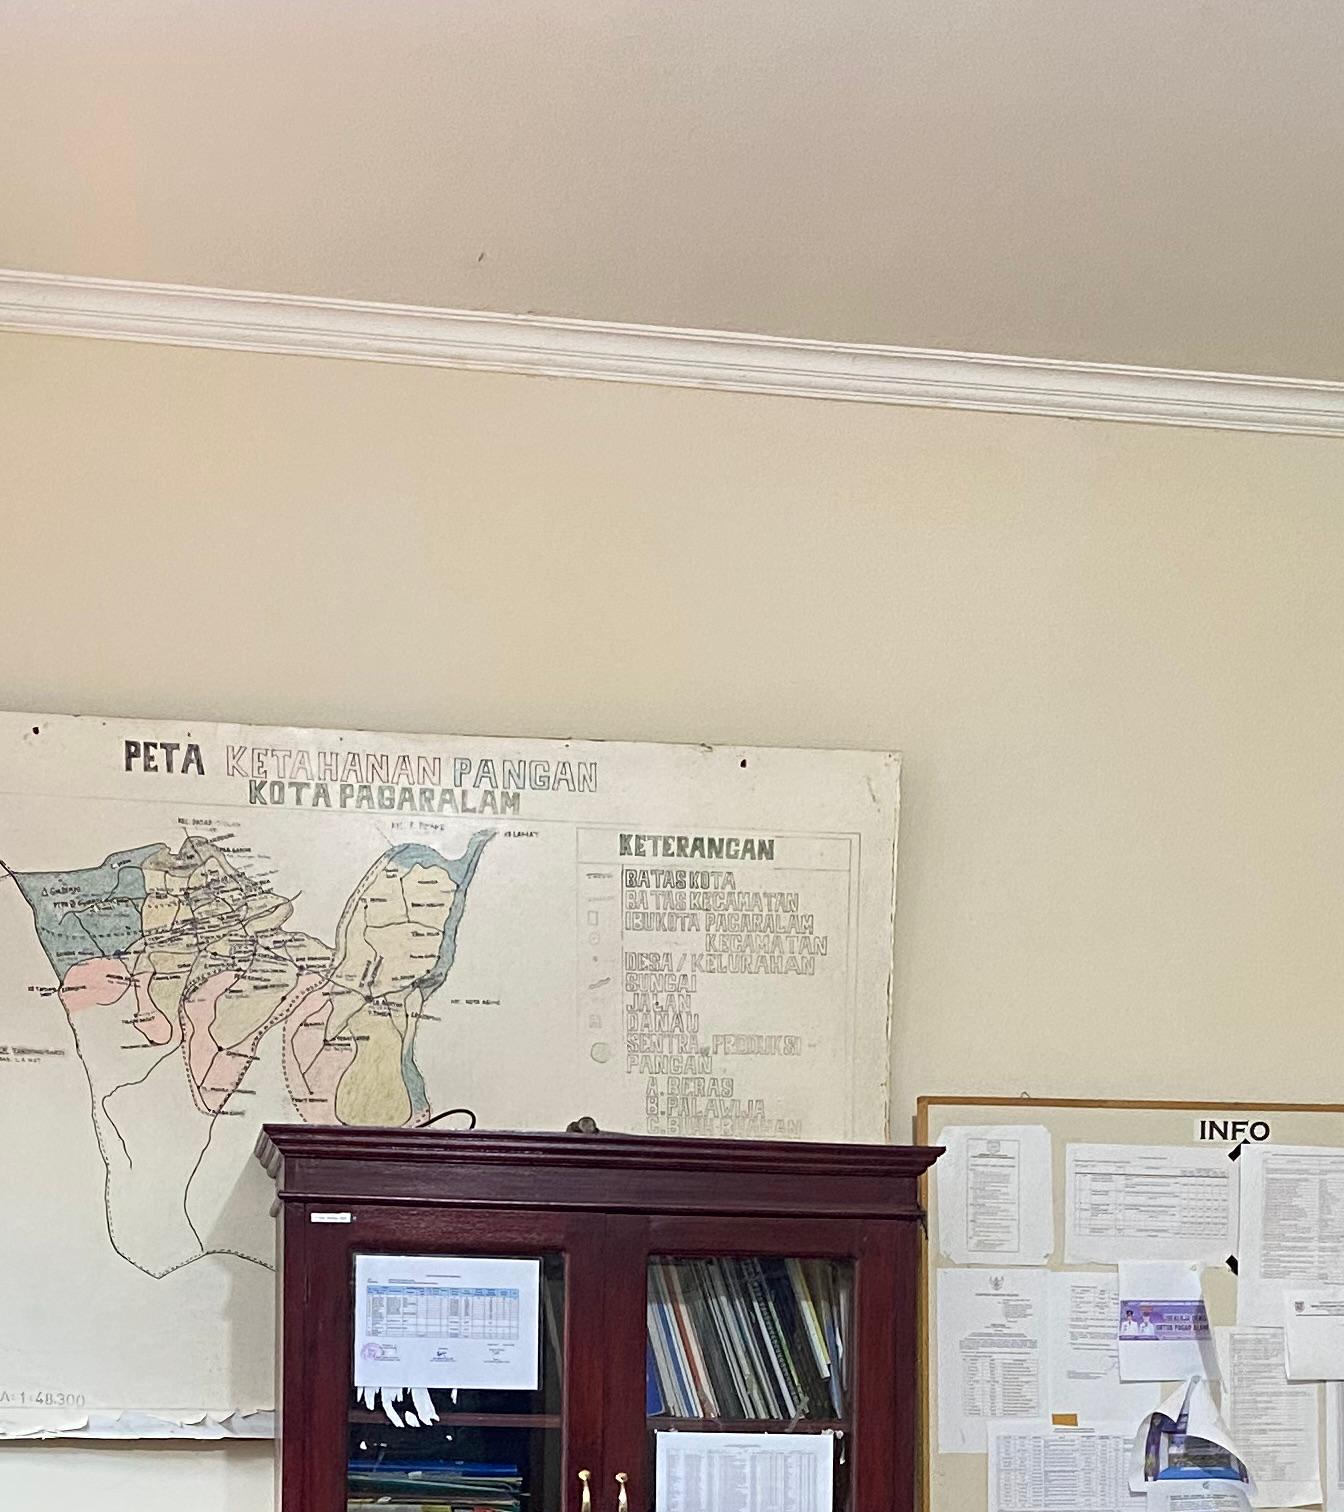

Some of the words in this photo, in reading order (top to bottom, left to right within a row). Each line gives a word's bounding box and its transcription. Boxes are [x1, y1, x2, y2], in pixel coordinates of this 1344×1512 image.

[124, 740, 205, 776] PETA
[225, 744, 442, 786] KETAHANAN
[453, 756, 598, 793] PANGAN
[248, 779, 333, 809] KOTA
[339, 784, 521, 816] PAGARALAM
[619, 834, 775, 861] KETERANGAN
[625, 869, 687, 889] BATAS
[689, 870, 737, 890] KOTA
[625, 890, 687, 910] BATAS
[689, 891, 799, 913] KECAMATAN
[625, 912, 701, 932] IBUKOTA
[705, 933, 828, 956] KECAMATAN
[625, 952, 674, 972] DESA
[691, 953, 816, 976] KELURAHAN
[625, 972, 698, 993] SUNGAI
[626, 993, 692, 1013] JALAN
[626, 1012, 700, 1033] DANAU
[626, 1054, 713, 1075] PANGAN
[1199, 1120, 1270, 1142] INFO
